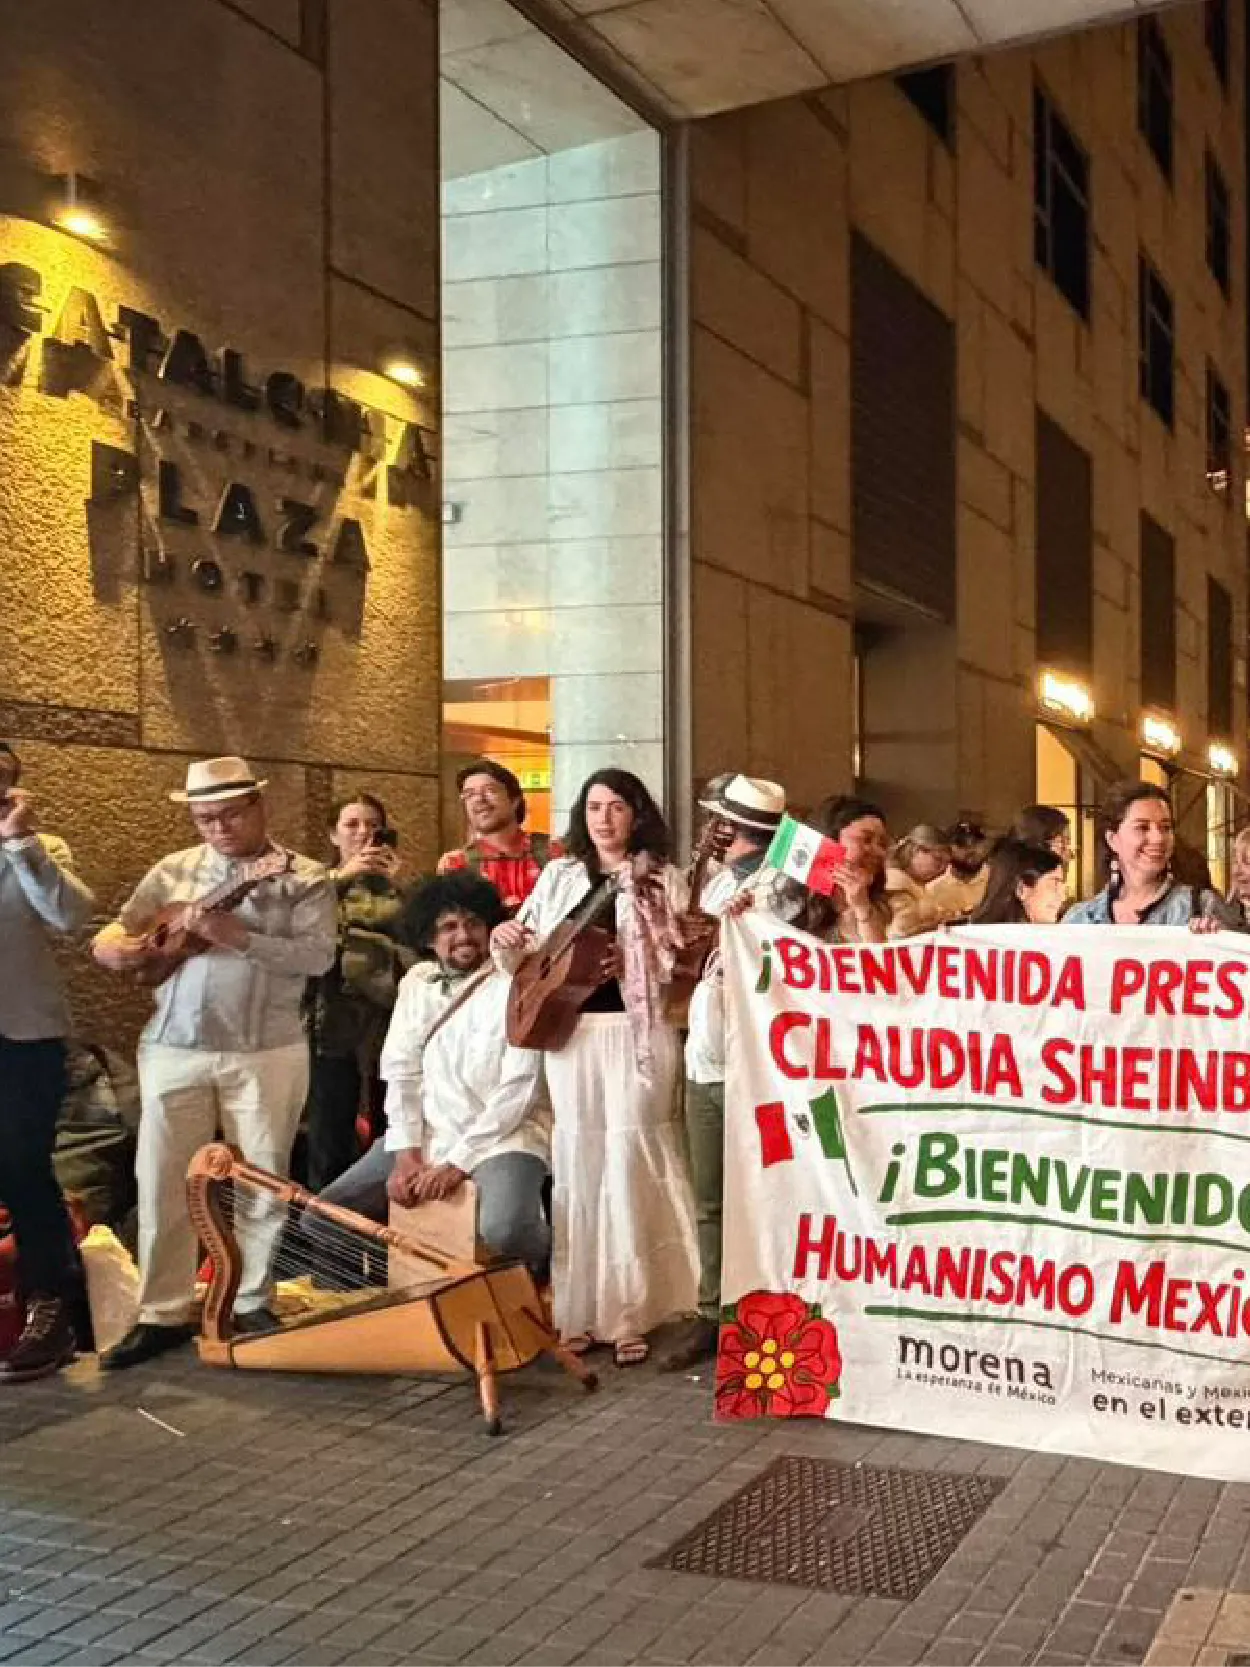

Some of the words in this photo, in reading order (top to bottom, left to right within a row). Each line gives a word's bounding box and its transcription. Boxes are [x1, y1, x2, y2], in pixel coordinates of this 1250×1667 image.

[87, 440, 372, 572] PLAZA
[755, 937, 1086, 1011] ¡BIENVENIDA
[768, 1010, 1023, 1098] CLAUDIA
[792, 1213, 1095, 1318] HUMANISMO
[898, 1335, 1053, 1390] morena
[1091, 1367, 1183, 1395] Mexicanas
[1187, 1385, 1197, 1400] y
[1092, 1393, 1128, 1415] en
[1139, 1397, 1166, 1421] el
